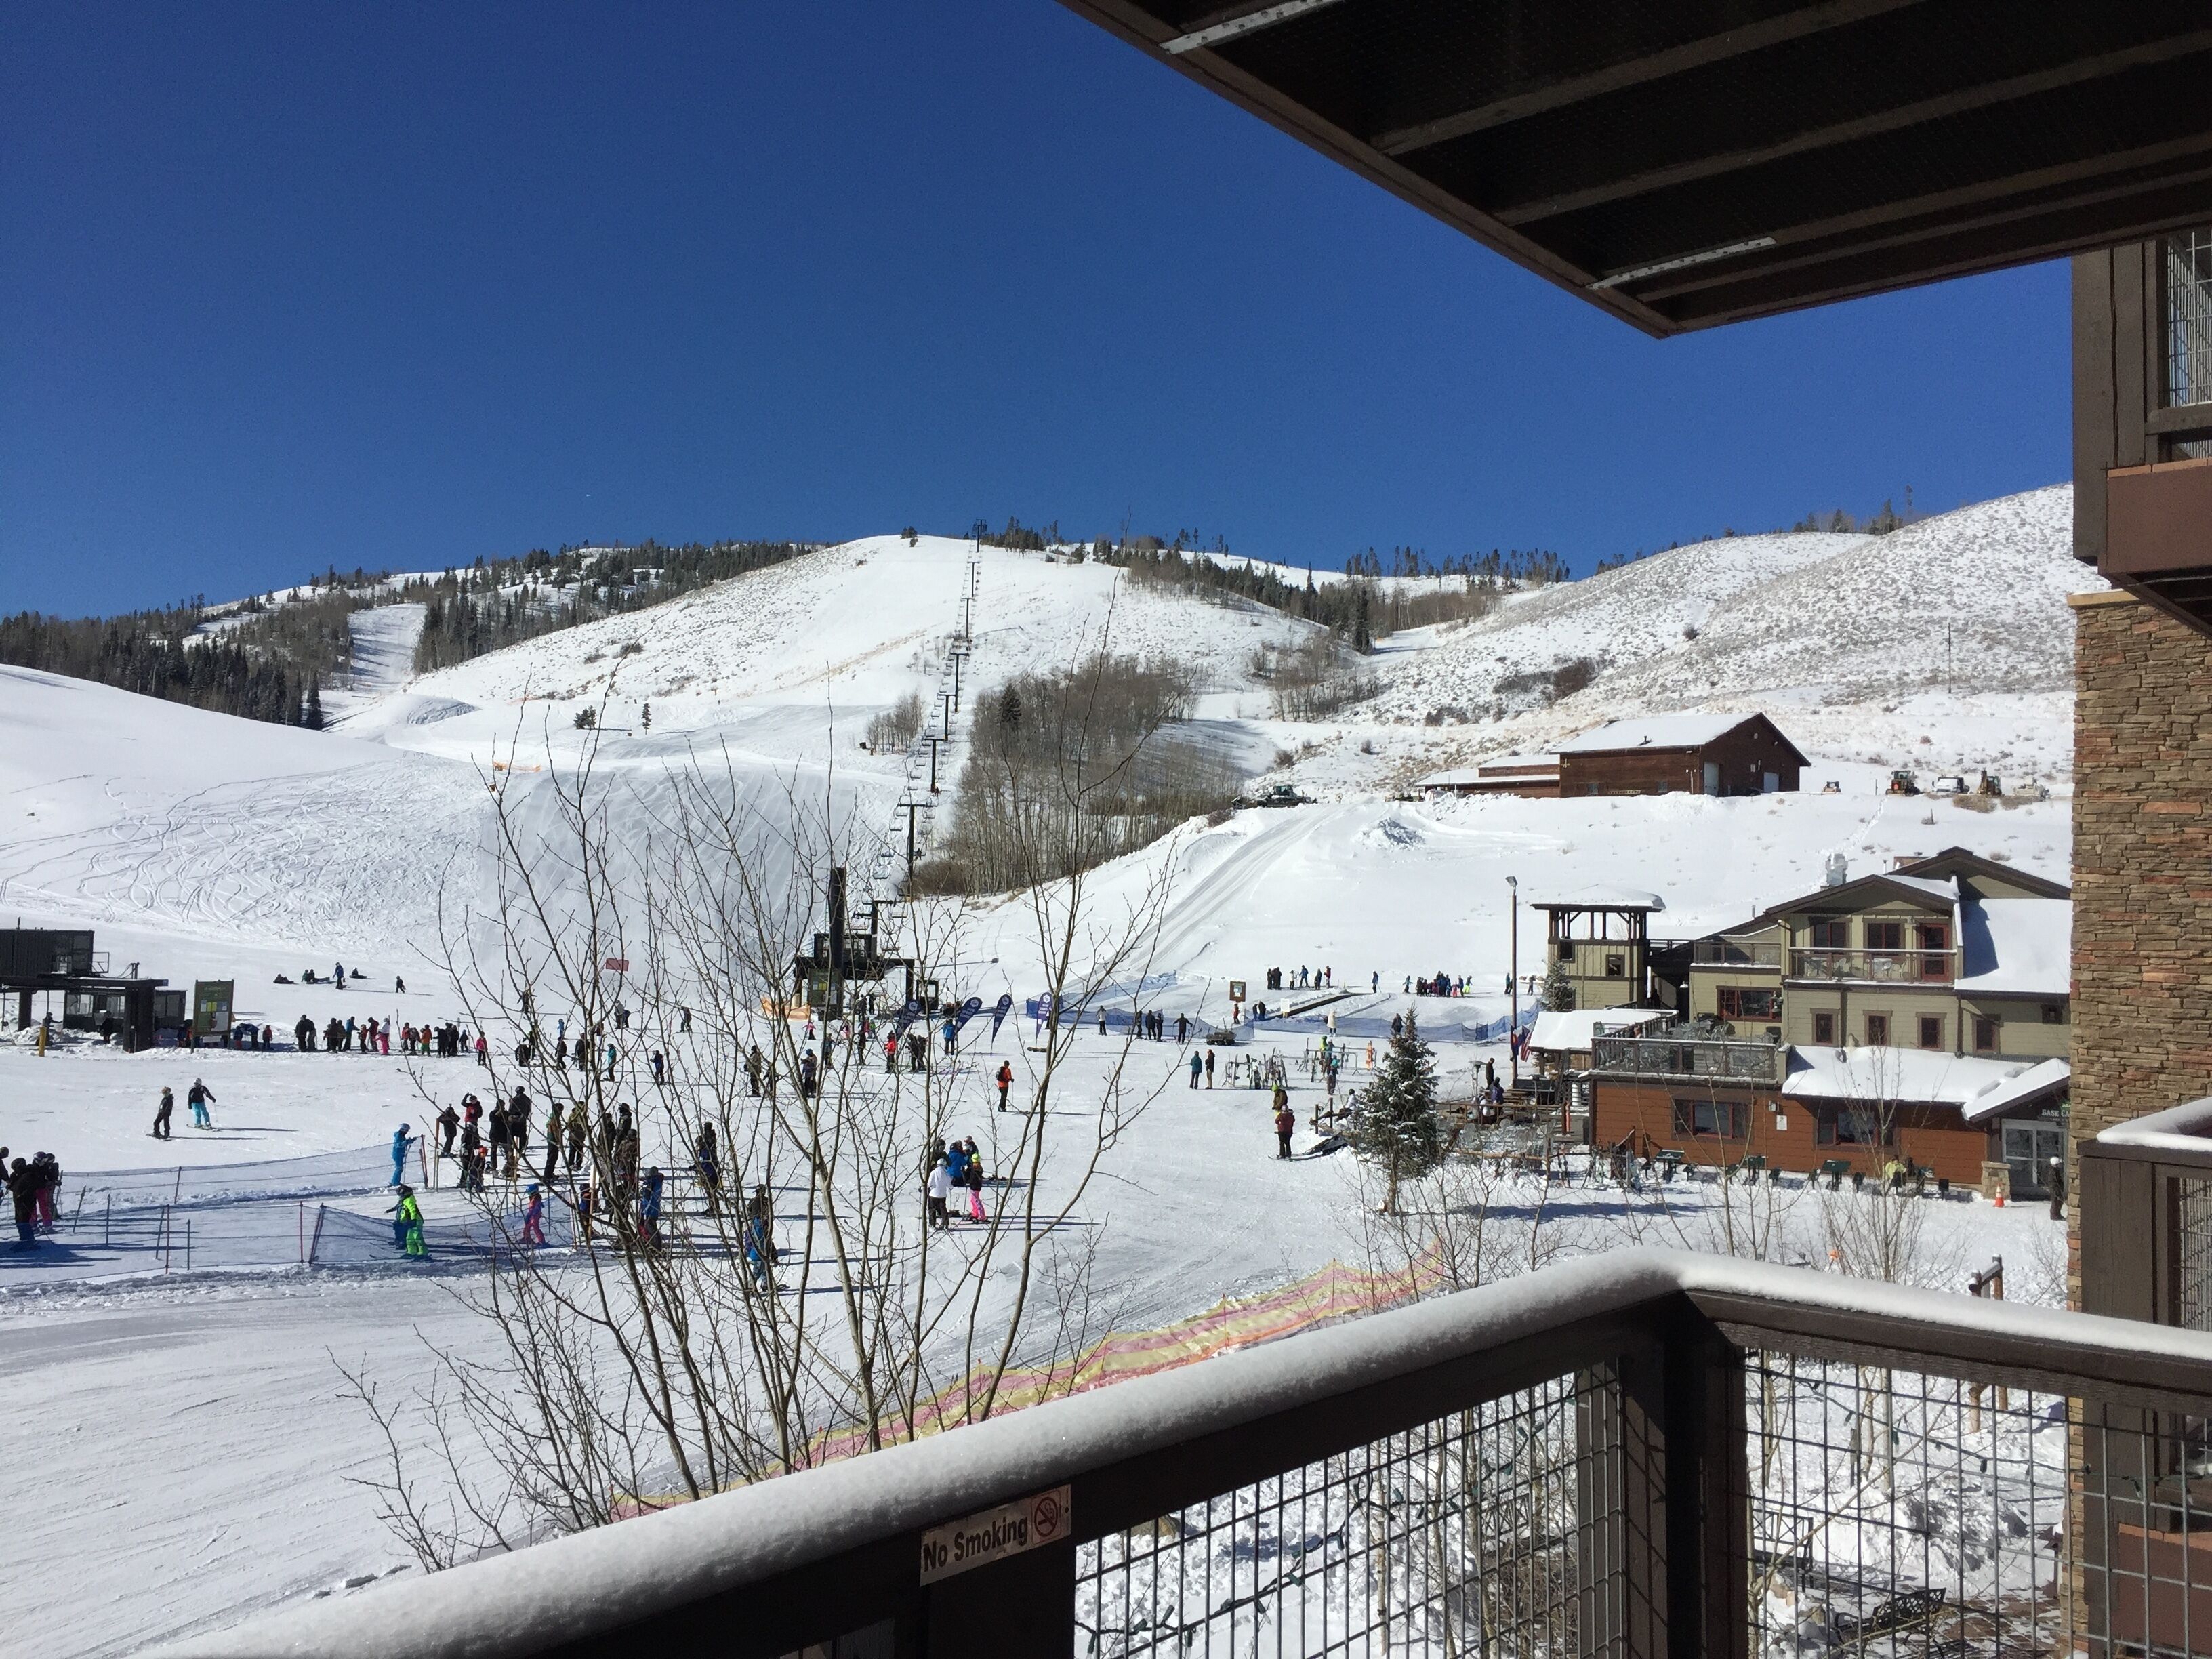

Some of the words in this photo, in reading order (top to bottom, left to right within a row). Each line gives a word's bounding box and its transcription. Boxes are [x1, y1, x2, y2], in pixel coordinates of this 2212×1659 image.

[2042, 1109, 2060, 1118] BASE
[923, 1540, 948, 1572] No
[954, 1515, 1028, 1561] Smoking
